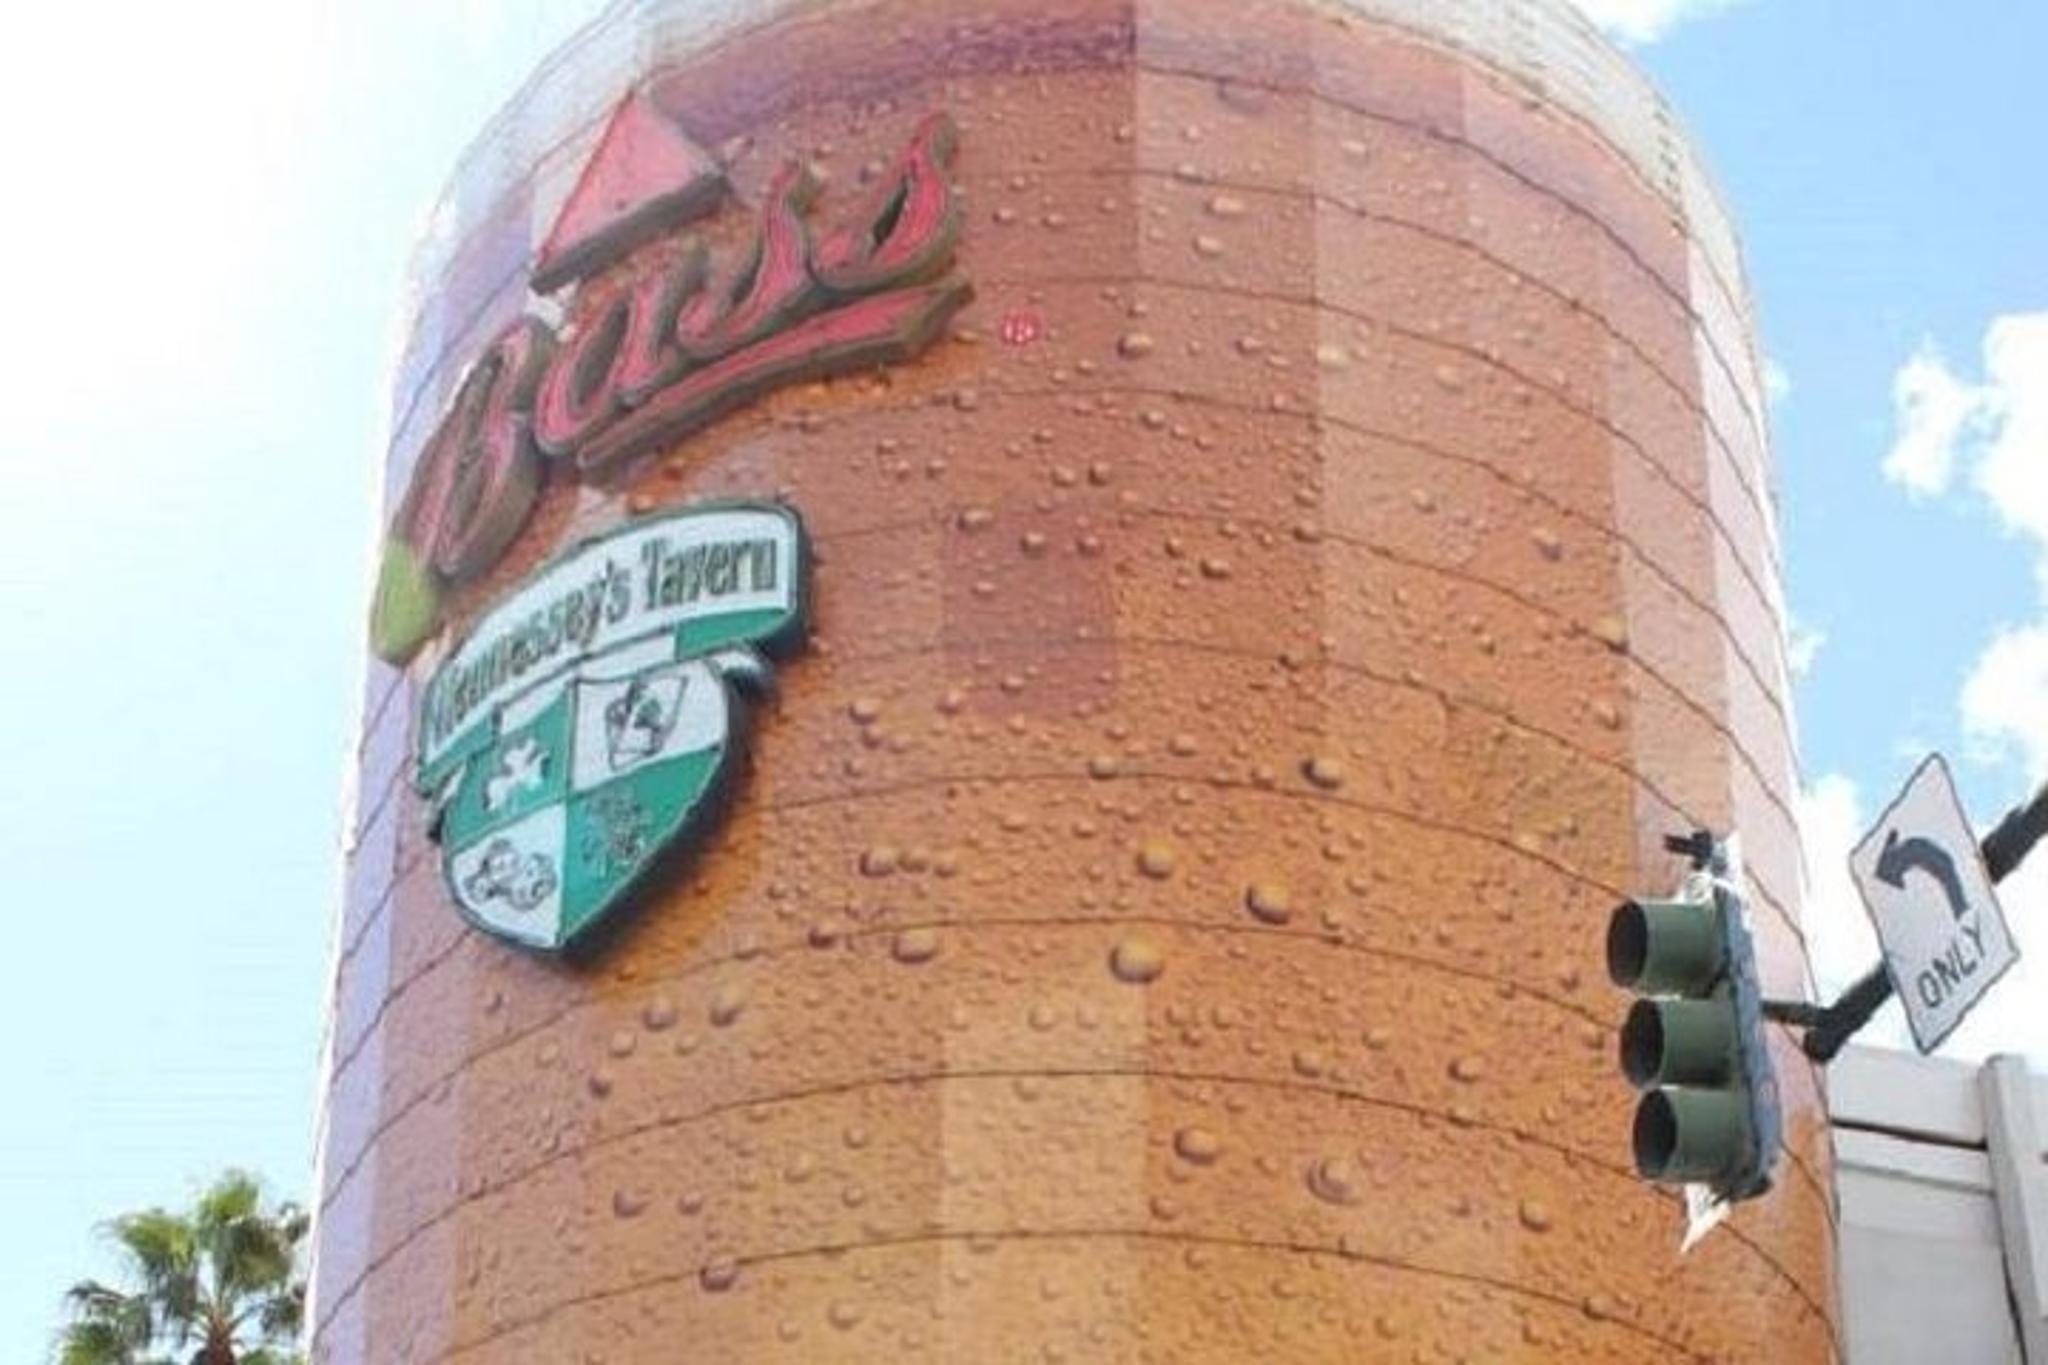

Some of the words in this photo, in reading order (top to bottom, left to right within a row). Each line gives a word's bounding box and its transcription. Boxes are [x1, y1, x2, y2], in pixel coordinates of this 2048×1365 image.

[402, 110, 962, 586] Bass
[641, 538, 778, 611] Tavern
[1916, 912, 1986, 1009] ONLY
